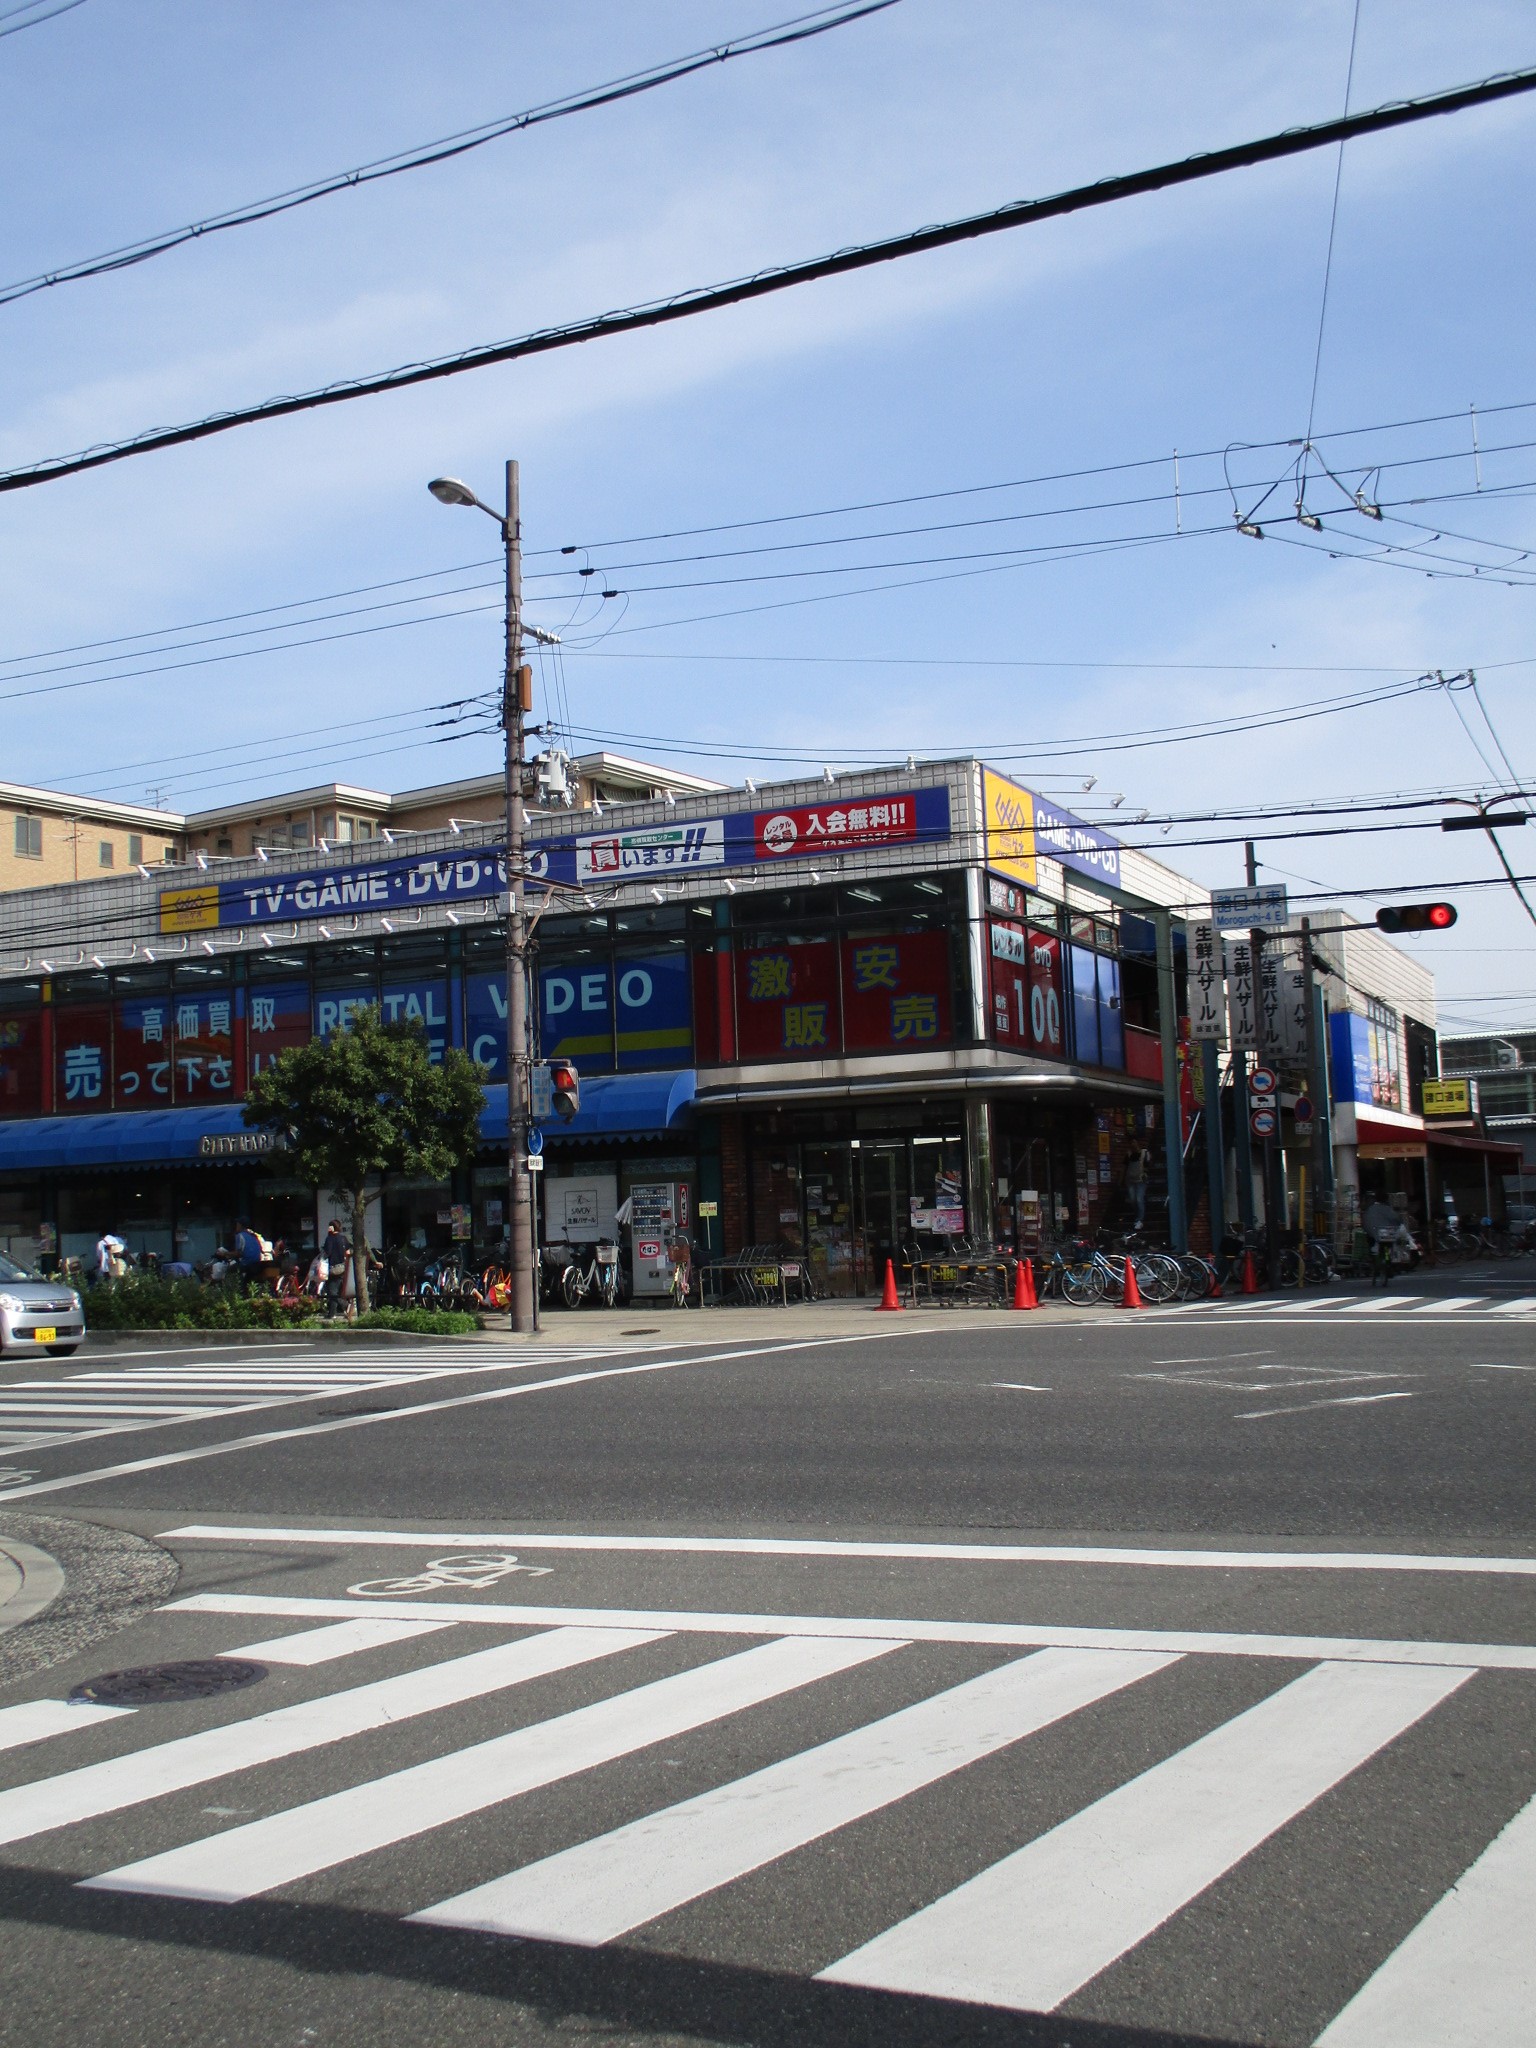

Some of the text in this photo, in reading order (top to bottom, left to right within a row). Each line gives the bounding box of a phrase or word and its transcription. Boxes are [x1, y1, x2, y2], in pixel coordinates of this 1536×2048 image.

[766, 820, 792, 835] レンタル
[1216, 912, 1271, 926] Moroguchi-4
[1034, 945, 1052, 968] DVD
[1194, 926, 1217, 1022] 生鮮バザール
[488, 969, 654, 1019] VDEO
[141, 997, 276, 1044] 高価買取
